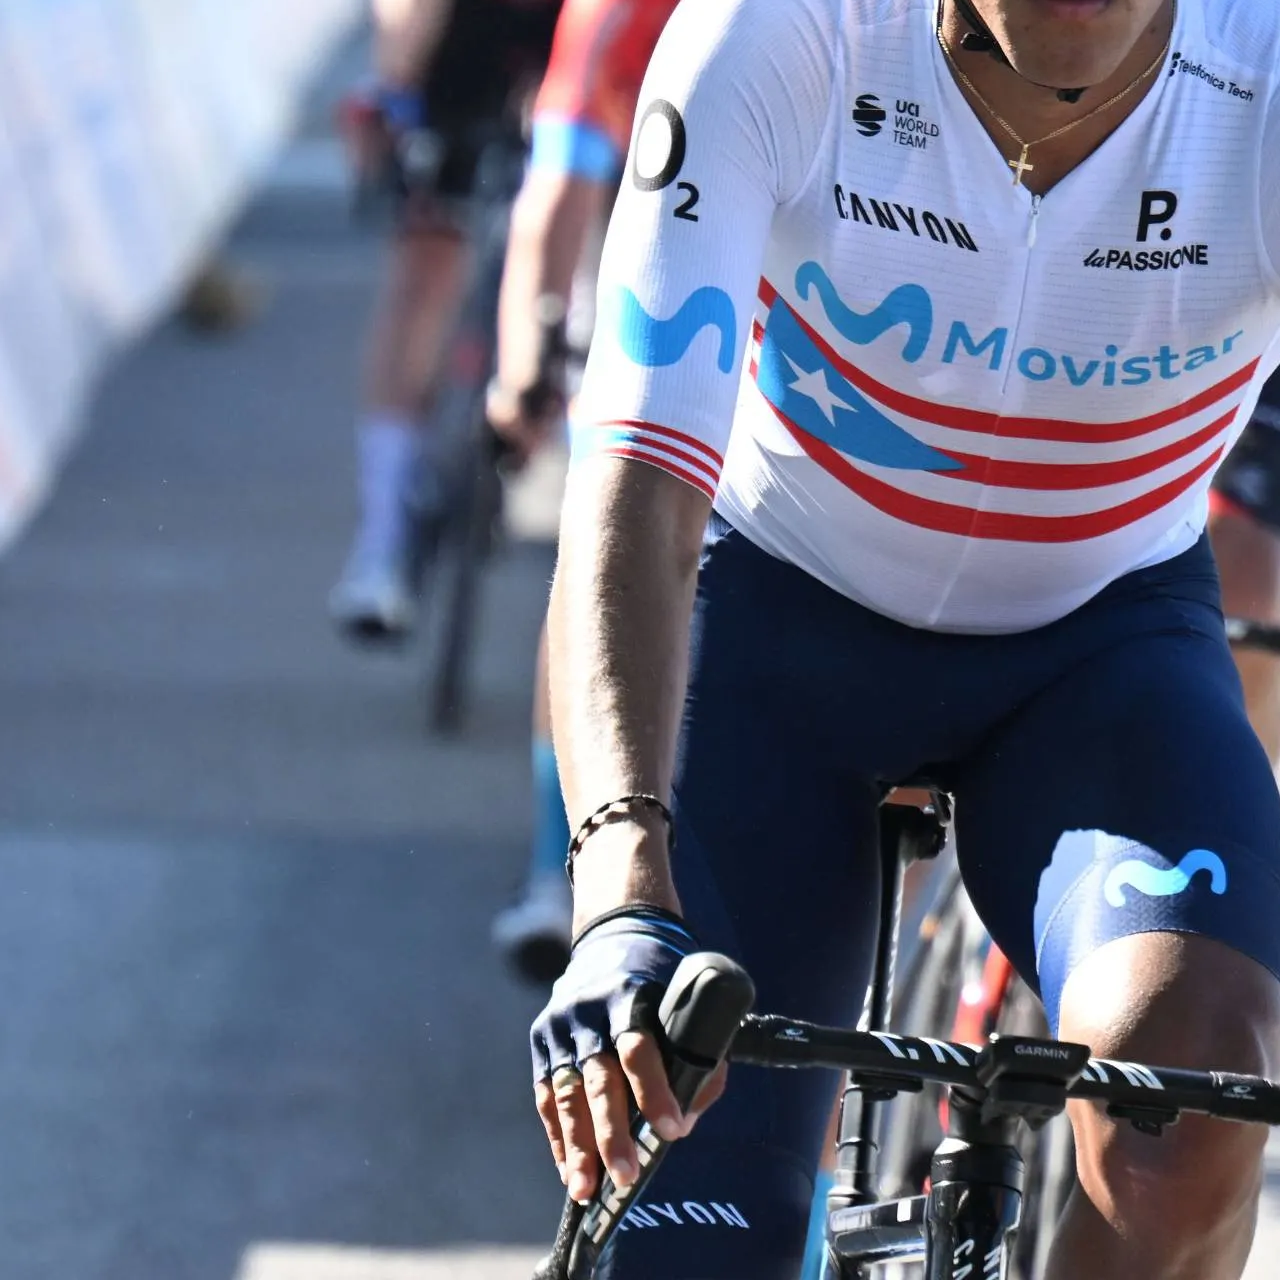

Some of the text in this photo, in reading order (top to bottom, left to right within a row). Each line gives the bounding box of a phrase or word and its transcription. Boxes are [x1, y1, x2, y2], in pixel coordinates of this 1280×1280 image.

[1228, 81, 1255, 102] Tech
[895, 99, 921, 118] UCI
[894, 114, 940, 138] WORLD
[892, 129, 928, 150] TEAM
[834, 183, 980, 253] CANYON
[941, 320, 1244, 389] Movistar
[1014, 1044, 1069, 1060] GARMIN
[618, 1201, 750, 1232] NYON
